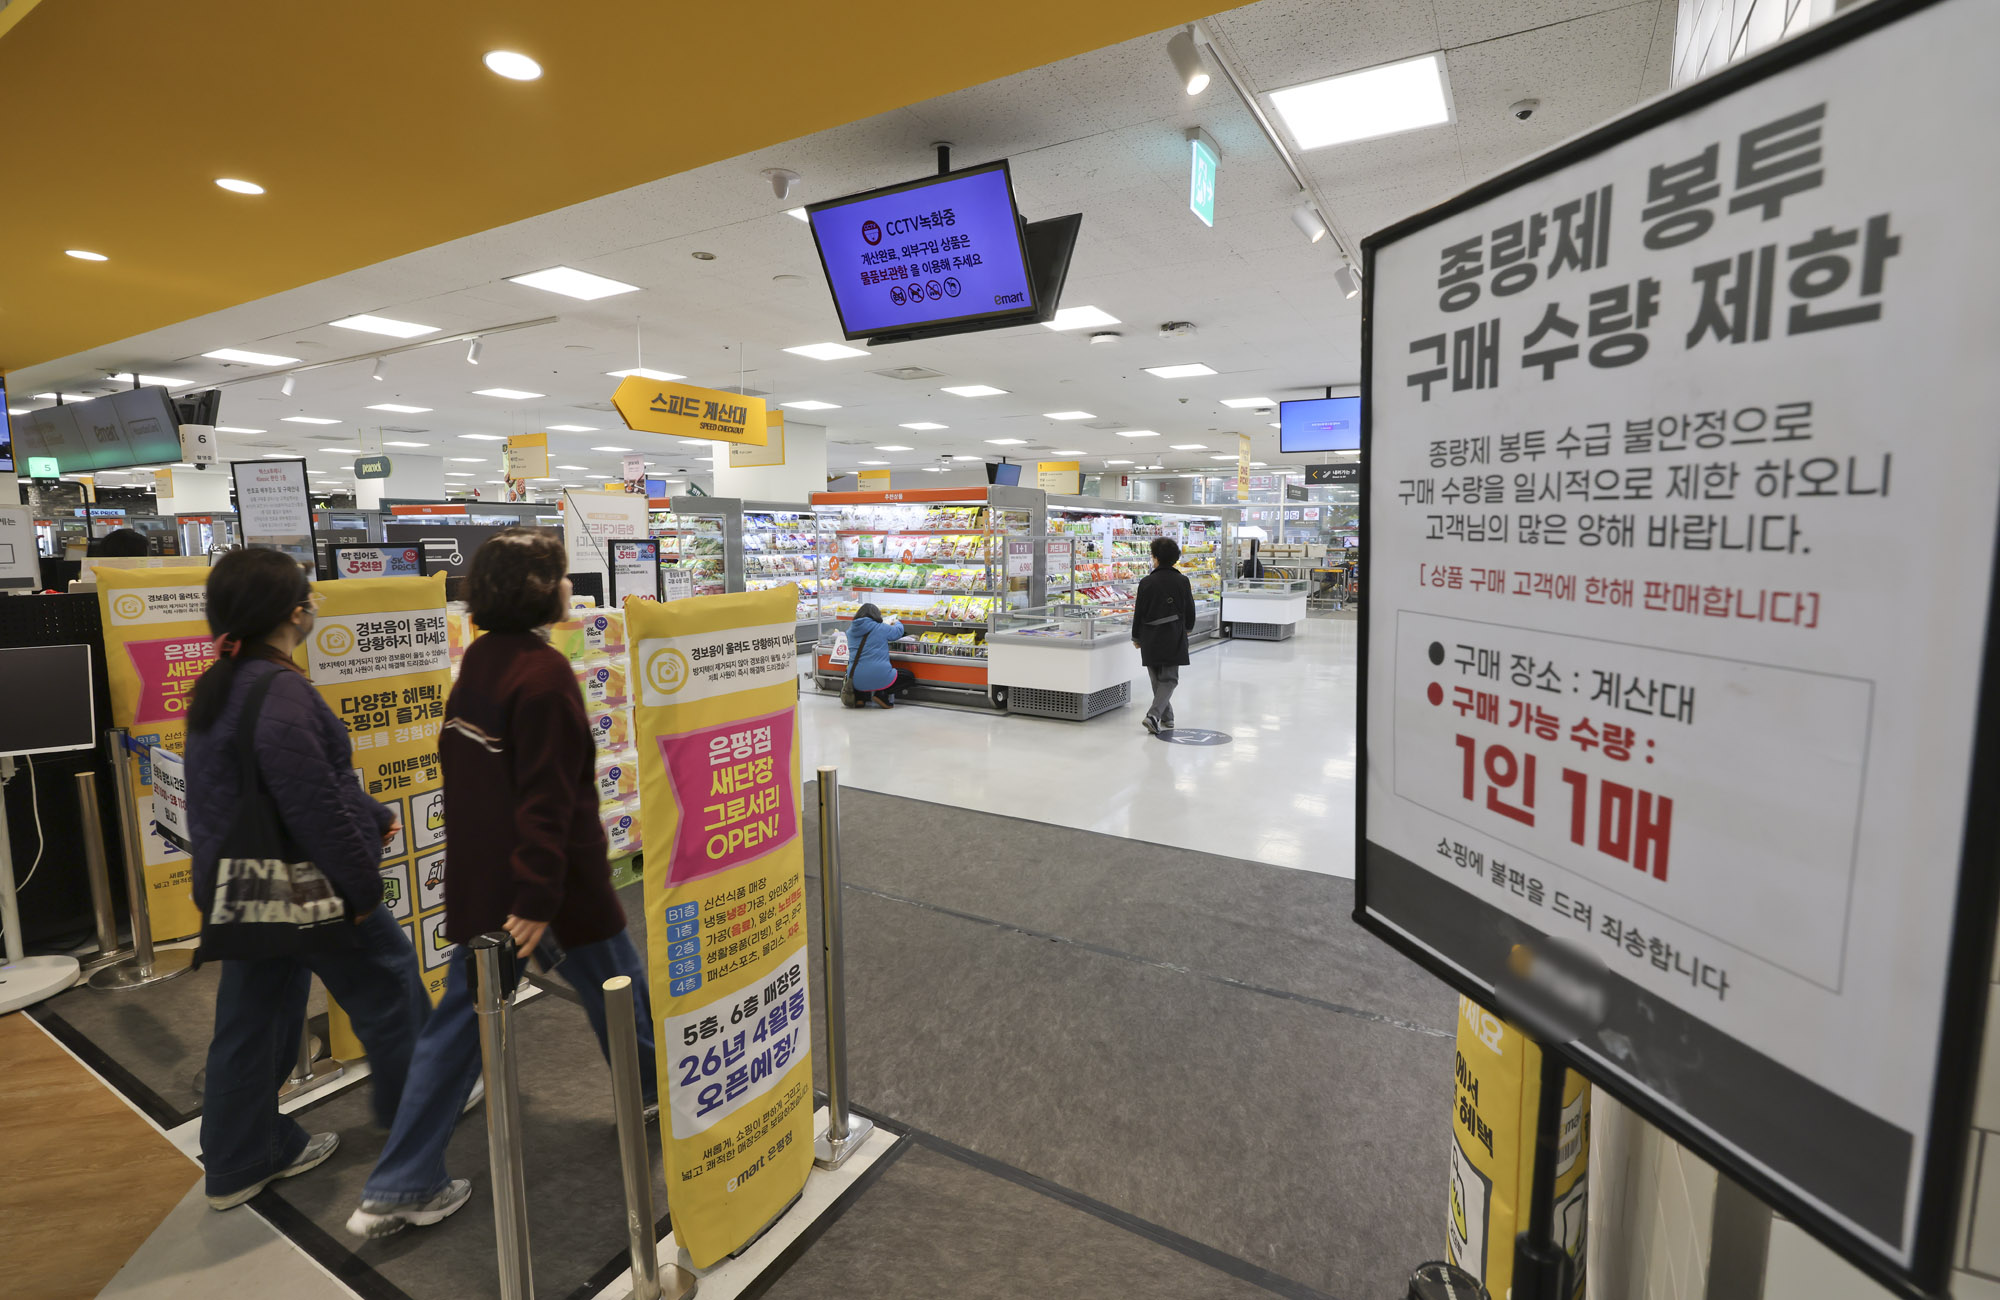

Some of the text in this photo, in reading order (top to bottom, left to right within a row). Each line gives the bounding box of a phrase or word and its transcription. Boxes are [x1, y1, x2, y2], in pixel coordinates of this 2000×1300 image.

[886, 208, 956, 237] CCTV녹화중
[1437, 102, 1827, 313] 종량제 봉투
[860, 252, 983, 286] 물품보관함 을 이용해 주세요
[861, 233, 971, 266] 계산완료, 외부구입 상품은
[994, 291, 1025, 306] emart
[1407, 212, 1900, 402] 구매 수량 제한
[650, 392, 747, 425] 스피드 계산대
[700, 422, 744, 435] SPEED CHECKOUT
[198, 434, 206, 444] 6
[1429, 402, 1814, 468] 종량제 봉투 수급 불안정으로
[362, 461, 382, 474] peacock
[1398, 452, 1893, 506] 구매 수량을 일시적으로 제한 하오니
[1016, 544, 1028, 554] 1+1
[1425, 514, 1811, 555] 고객님의 많은 양해 바랍니다.
[342, 552, 351, 560] 막
[347, 561, 382, 574] 5천원
[618, 551, 636, 560] 5천원
[148, 592, 200, 602] 경보음이 울려도
[1430, 565, 1464, 590] 상품
[1469, 567, 1506, 595] 구매
[1512, 571, 1577, 602] 고객에
[1584, 576, 1634, 609] 한해
[1643, 581, 1821, 629] 판매합니다]
[356, 616, 444, 636] 경보음이 울려도
[358, 631, 446, 652] 당황하지 마세요
[348, 657, 374, 666] 제거되지
[388, 652, 412, 662] 경보음이
[692, 636, 780, 660] 경보음이 울려도 당황하지
[715, 661, 737, 671] 제거되지
[750, 654, 770, 666] 경보음이
[354, 664, 373, 674] 사원이
[720, 670, 736, 680] 사원이
[1454, 643, 1500, 683] 구매
[1509, 652, 1563, 695] 장소
[1591, 668, 1696, 725] 계산대
[341, 684, 442, 714] 다양한 혜택!
[396, 701, 444, 724] 즐거움
[352, 731, 390, 752] 트를
[1452, 685, 1499, 726] 구매
[1507, 697, 1560, 742] 가능
[1569, 714, 1635, 764] 수량
[708, 726, 772, 766] 은평점
[369, 776, 412, 795] 즐기는
[710, 756, 774, 797] 새단장
[704, 784, 780, 832] 그로서리
[1455, 732, 1674, 883] 1인 1매
[706, 814, 780, 860] OPEN!
[668, 877, 766, 921] B1층 신선식품 매장
[1436, 836, 1484, 878] 쇼핑에
[1489, 859, 1546, 908] 불편을
[1551, 890, 1593, 932] 드려
[1600, 913, 1732, 1002] 죄송합니다
[675, 942, 694, 957] 2층
[706, 917, 756, 946] 가공(음료),
[778, 888, 802, 913] 노브랜드
[675, 924, 692, 938] 1층
[675, 958, 695, 975] 3층
[706, 925, 774, 964] 생활용품(리빙),
[676, 978, 696, 992] 4층
[707, 950, 760, 982] 패션스포츠,
[762, 935, 786, 956] 몰리스
[683, 963, 800, 1047] 5층, 6층 매장은
[679, 987, 805, 1088] 26년 4월중
[696, 1026, 798, 1119] 오픈예정!
[1456, 1050, 1478, 1108] 에서
[702, 1082, 800, 1160] 새롭게, 쇼핑이 편하게 그리고
[1460, 1096, 1494, 1159] 혜택
[682, 1165, 704, 1182] 넓고
[706, 1149, 736, 1171] 쾌적한
[738, 1124, 768, 1154] 매장으로
[727, 1130, 792, 1192] emart 은평점
